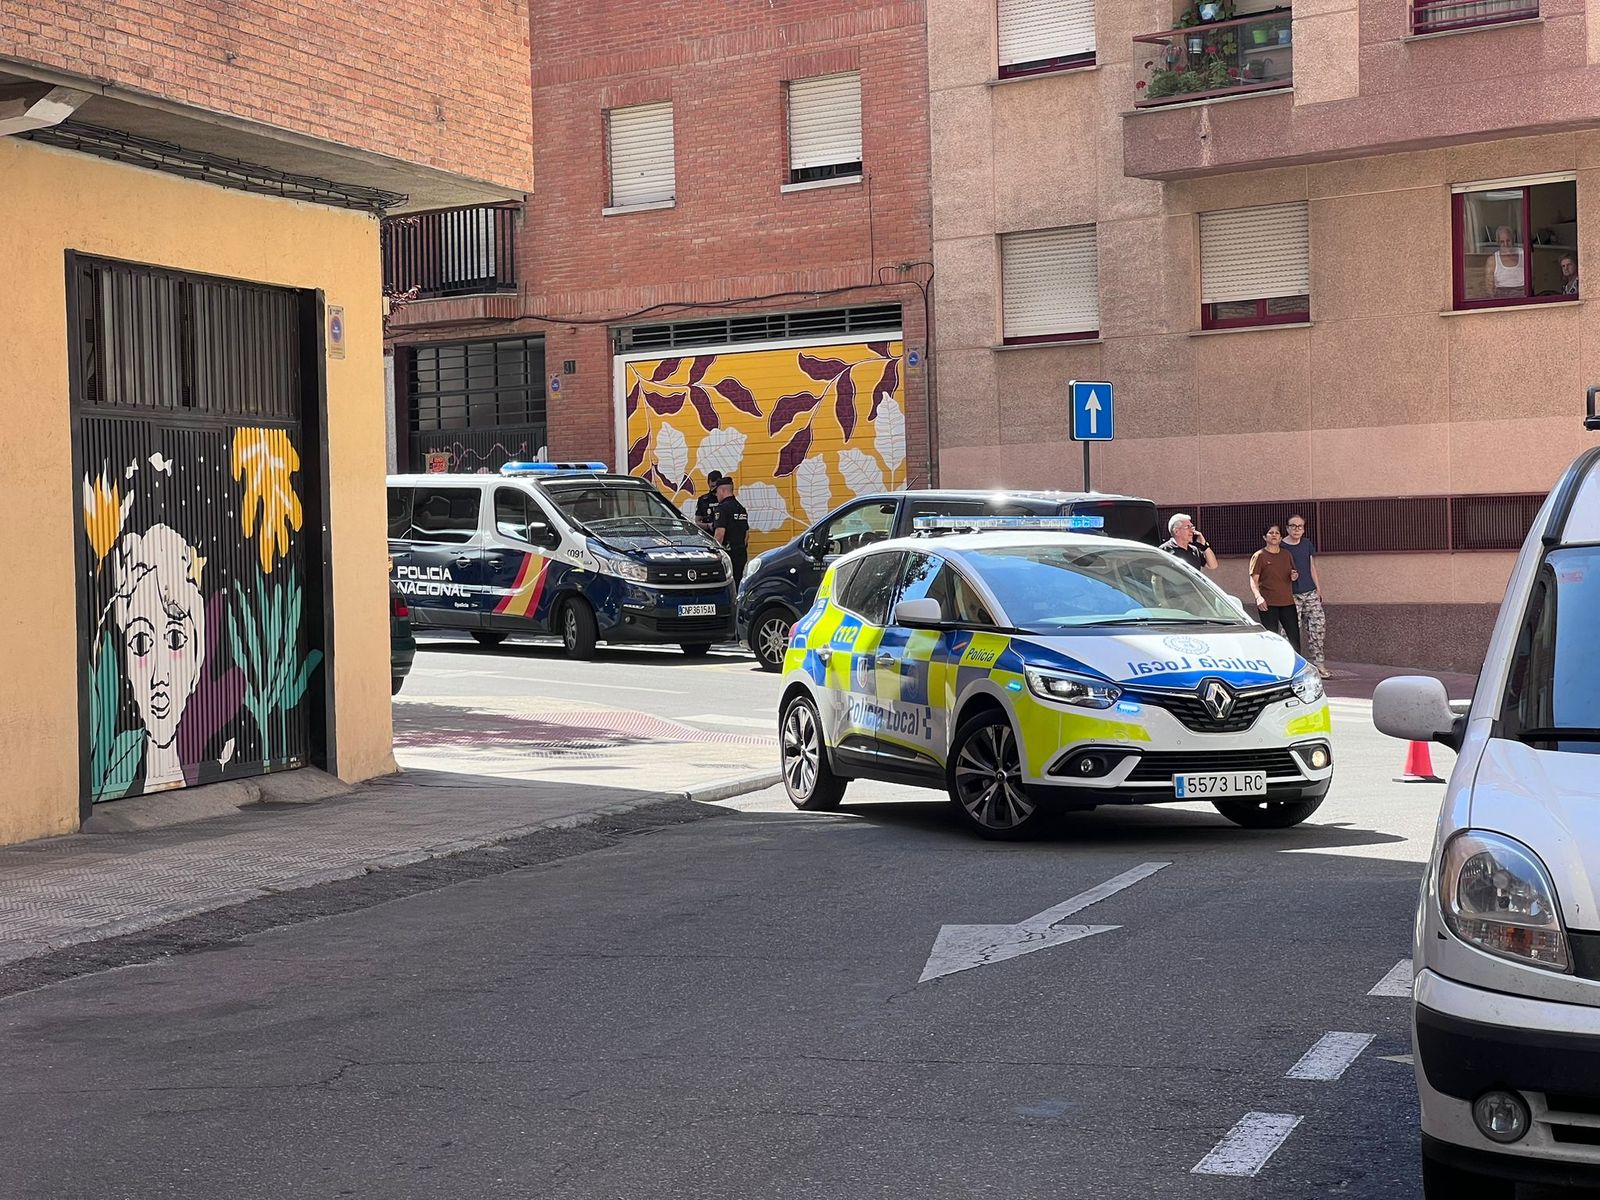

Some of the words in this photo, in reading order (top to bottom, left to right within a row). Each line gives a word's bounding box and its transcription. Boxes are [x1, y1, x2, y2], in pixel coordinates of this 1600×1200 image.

[397, 565, 453, 581] POLICÍA
[397, 581, 471, 598] NACIONAL
[966, 648, 995, 662] Policía
[847, 695, 884, 730] Policía
[886, 702, 920, 736] Local
[1188, 776, 1228, 793] 5573
[1234, 774, 1263, 792] LRC
